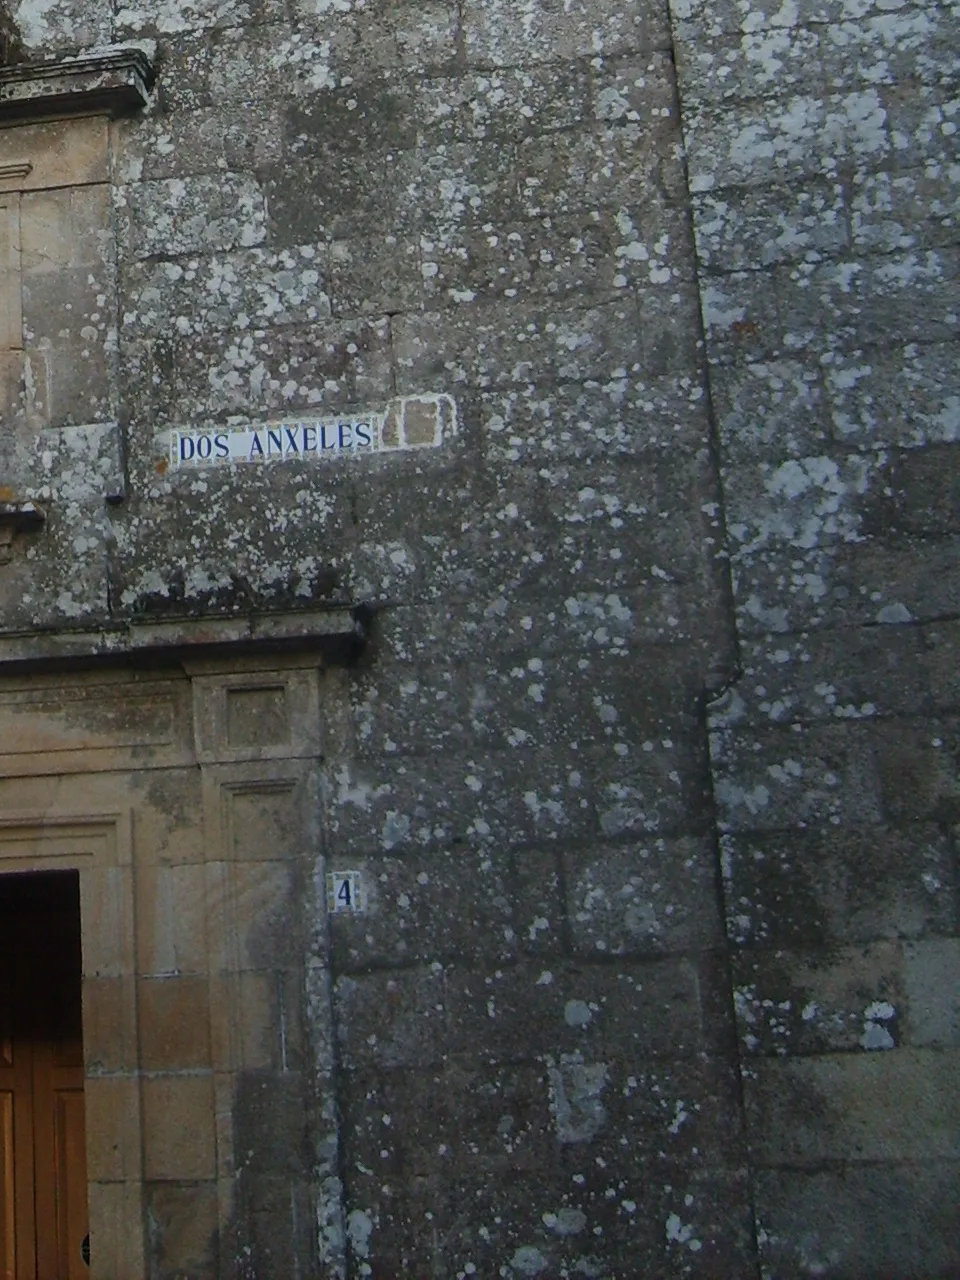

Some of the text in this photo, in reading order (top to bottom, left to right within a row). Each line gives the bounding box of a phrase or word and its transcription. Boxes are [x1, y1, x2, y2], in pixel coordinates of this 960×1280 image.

[179, 423, 372, 461] DOS ANXELES
[338, 879, 351, 906] 4
